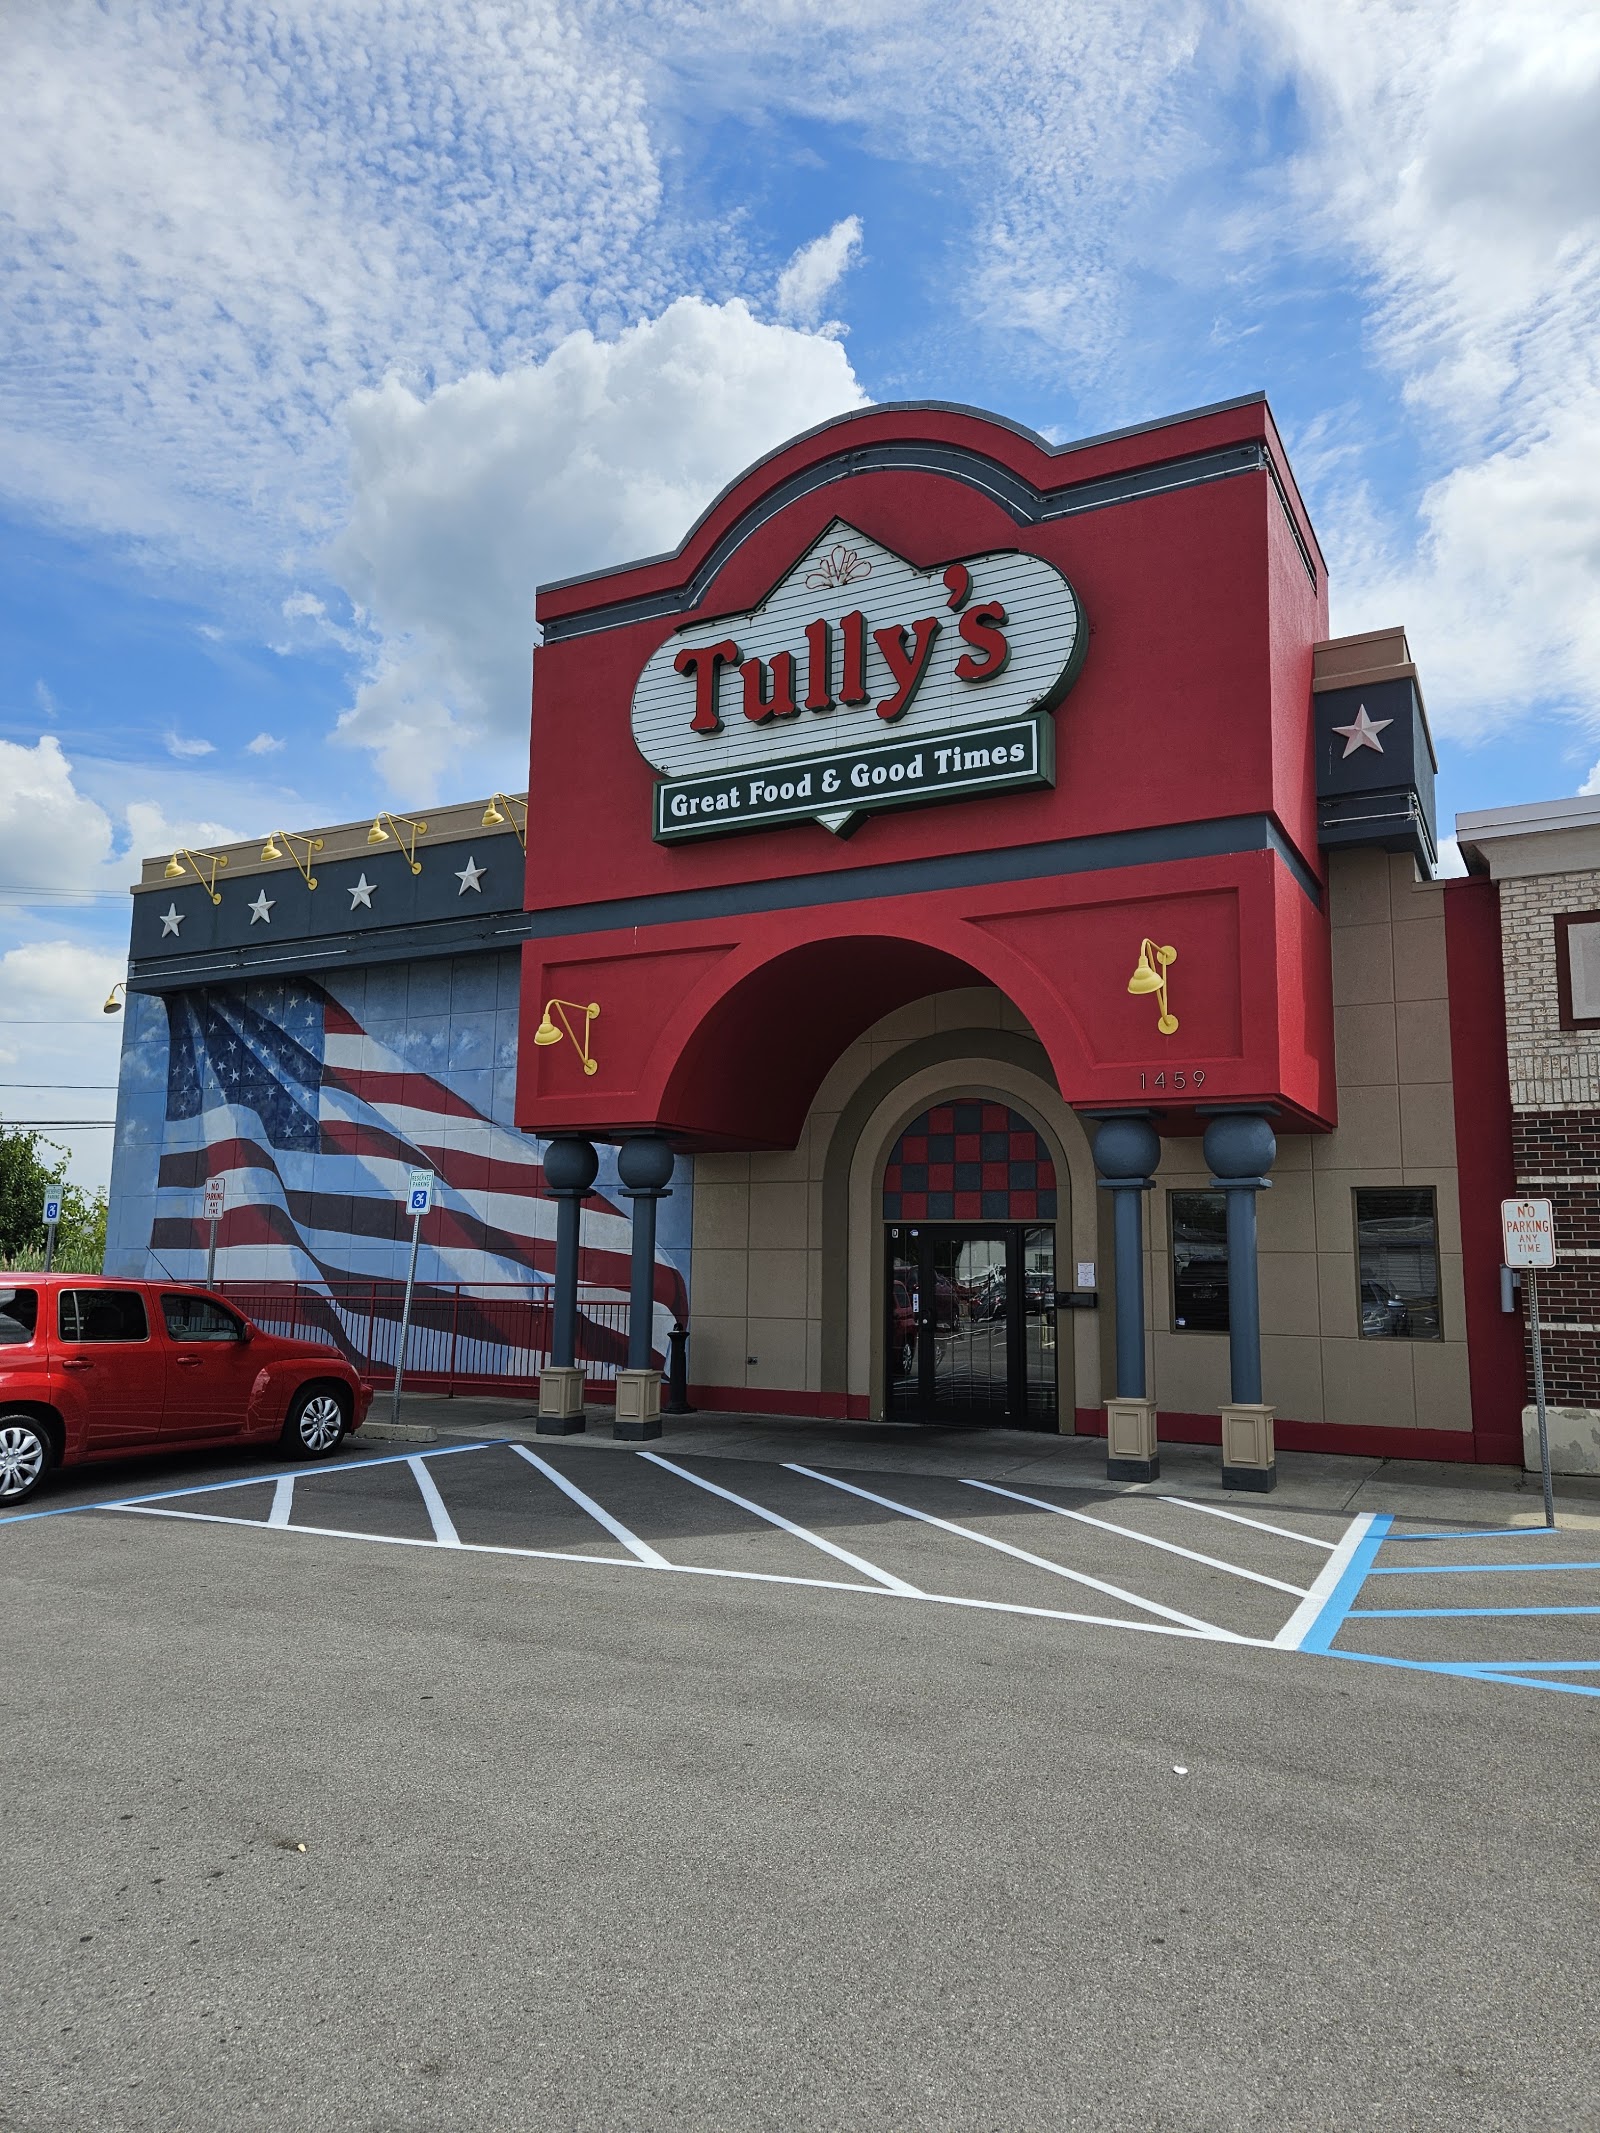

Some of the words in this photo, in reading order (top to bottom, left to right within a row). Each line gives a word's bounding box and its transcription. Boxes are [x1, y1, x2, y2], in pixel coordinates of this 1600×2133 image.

[674, 564, 1011, 734] Tully's
[671, 786, 740, 816] Great
[749, 773, 812, 805] Food
[821, 769, 841, 793] &
[851, 753, 923, 788] Good
[934, 743, 1025, 774] Times
[1140, 1070, 1205, 1089] 1459
[1517, 1206, 1535, 1217] NO
[1507, 1221, 1548, 1232] PARKING
[1519, 1234, 1537, 1242] ANY
[1518, 1244, 1541, 1252] TIME
